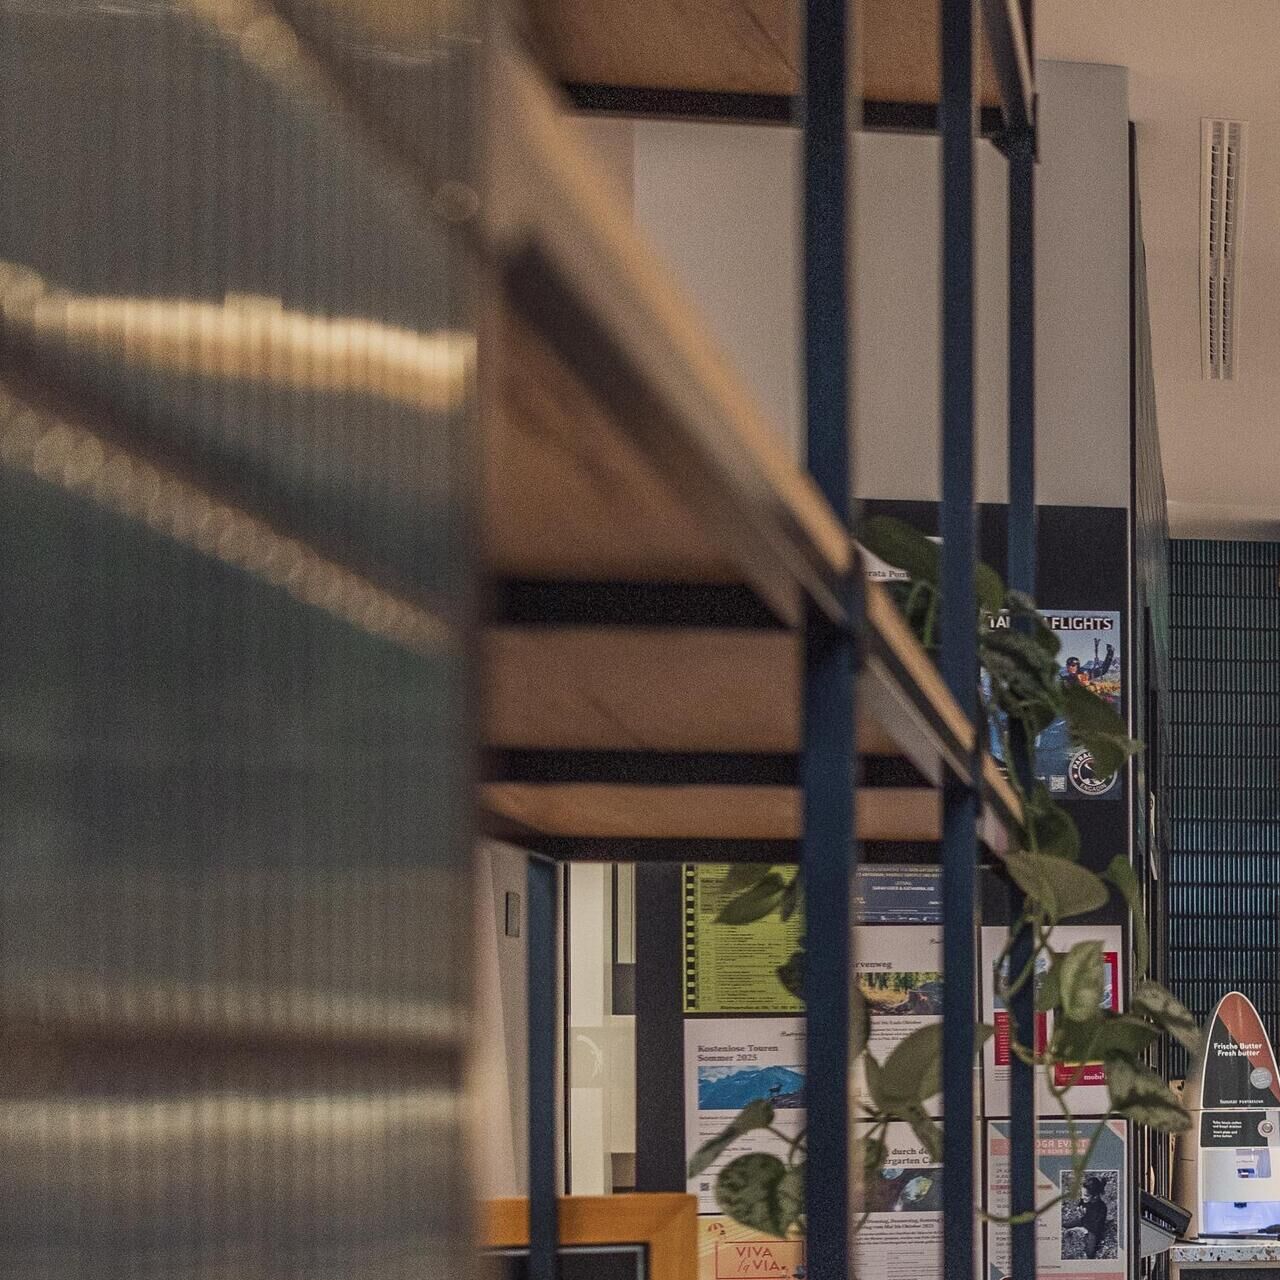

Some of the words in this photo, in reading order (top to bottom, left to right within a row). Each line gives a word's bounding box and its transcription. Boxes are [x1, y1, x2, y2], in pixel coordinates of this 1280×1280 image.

[1052, 616, 1112, 630] FLIGHTS
[855, 961, 892, 969] rvenweg
[698, 1044, 745, 1052] Kostenlose
[747, 1044, 778, 1052] Touren
[1214, 1042, 1238, 1050] Frische
[1240, 1042, 1262, 1050] Butter
[698, 1054, 734, 1062] Sommer
[892, 1148, 917, 1156] durch
[882, 1156, 920, 1166] ergarten
[736, 1246, 772, 1258] VIVA
[752, 1260, 780, 1271] VIA
